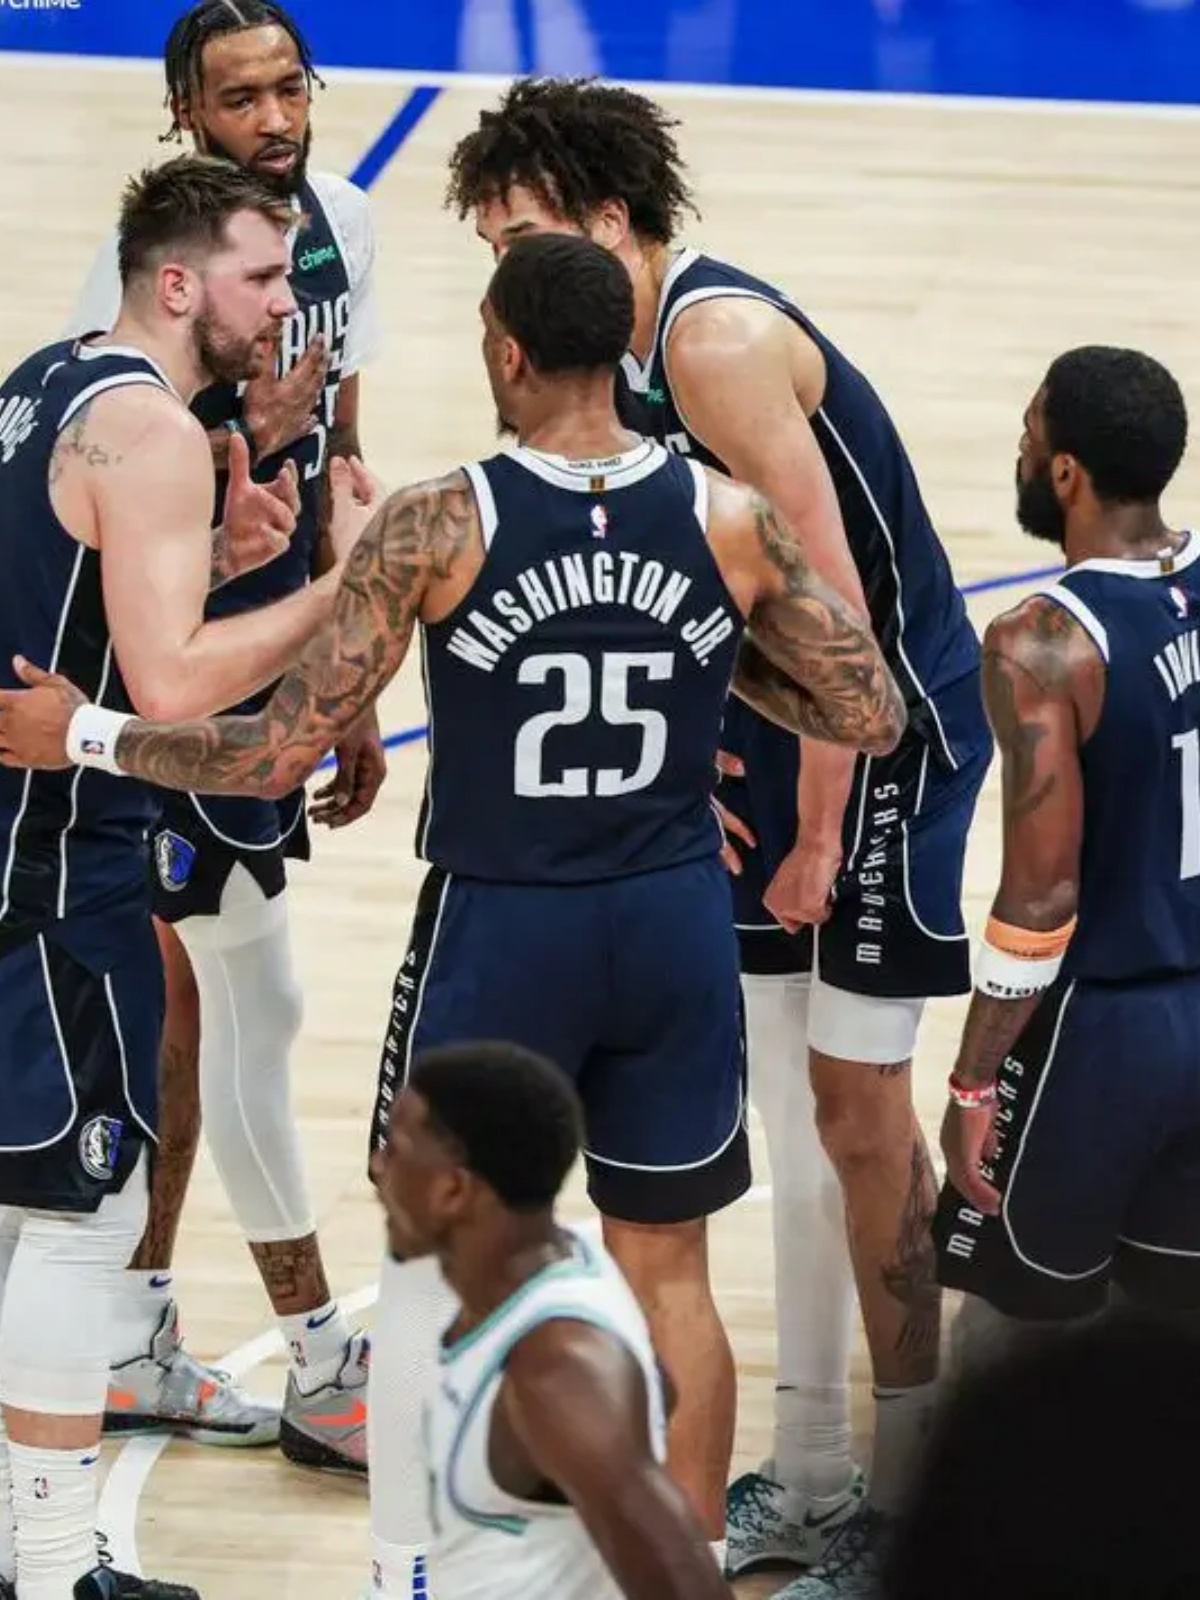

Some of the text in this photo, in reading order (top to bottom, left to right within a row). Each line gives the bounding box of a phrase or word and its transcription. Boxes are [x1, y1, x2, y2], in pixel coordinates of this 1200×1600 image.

[446, 551, 734, 673] WASHINGTON JR.
[514, 651, 675, 798] 25
